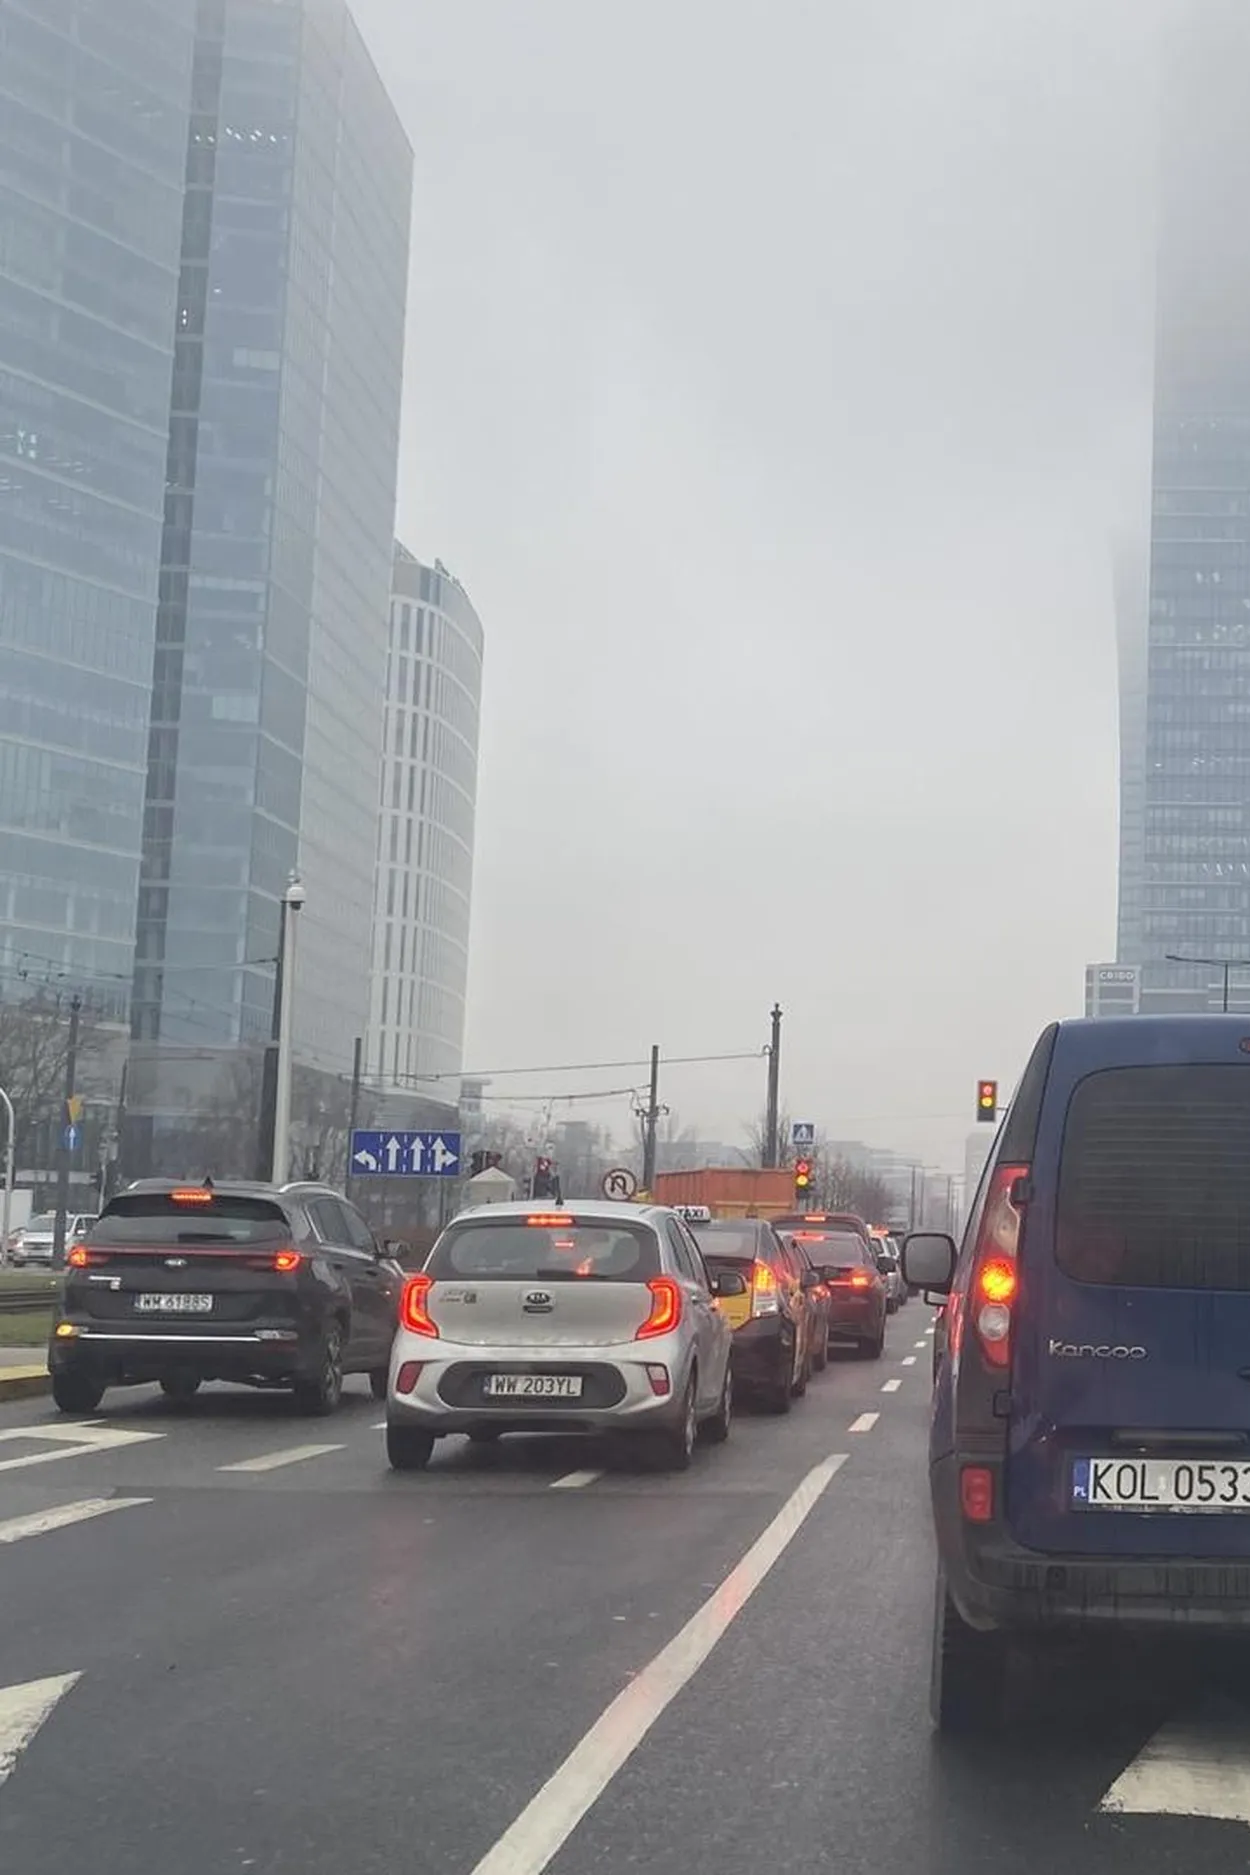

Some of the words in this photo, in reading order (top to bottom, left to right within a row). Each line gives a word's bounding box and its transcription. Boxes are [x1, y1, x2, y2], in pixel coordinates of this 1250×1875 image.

[677, 1207, 704, 1218] TAXI
[495, 1376, 518, 1393] WW
[523, 1377, 576, 1395] 203YL
[1092, 1463, 1160, 1501] KOL
